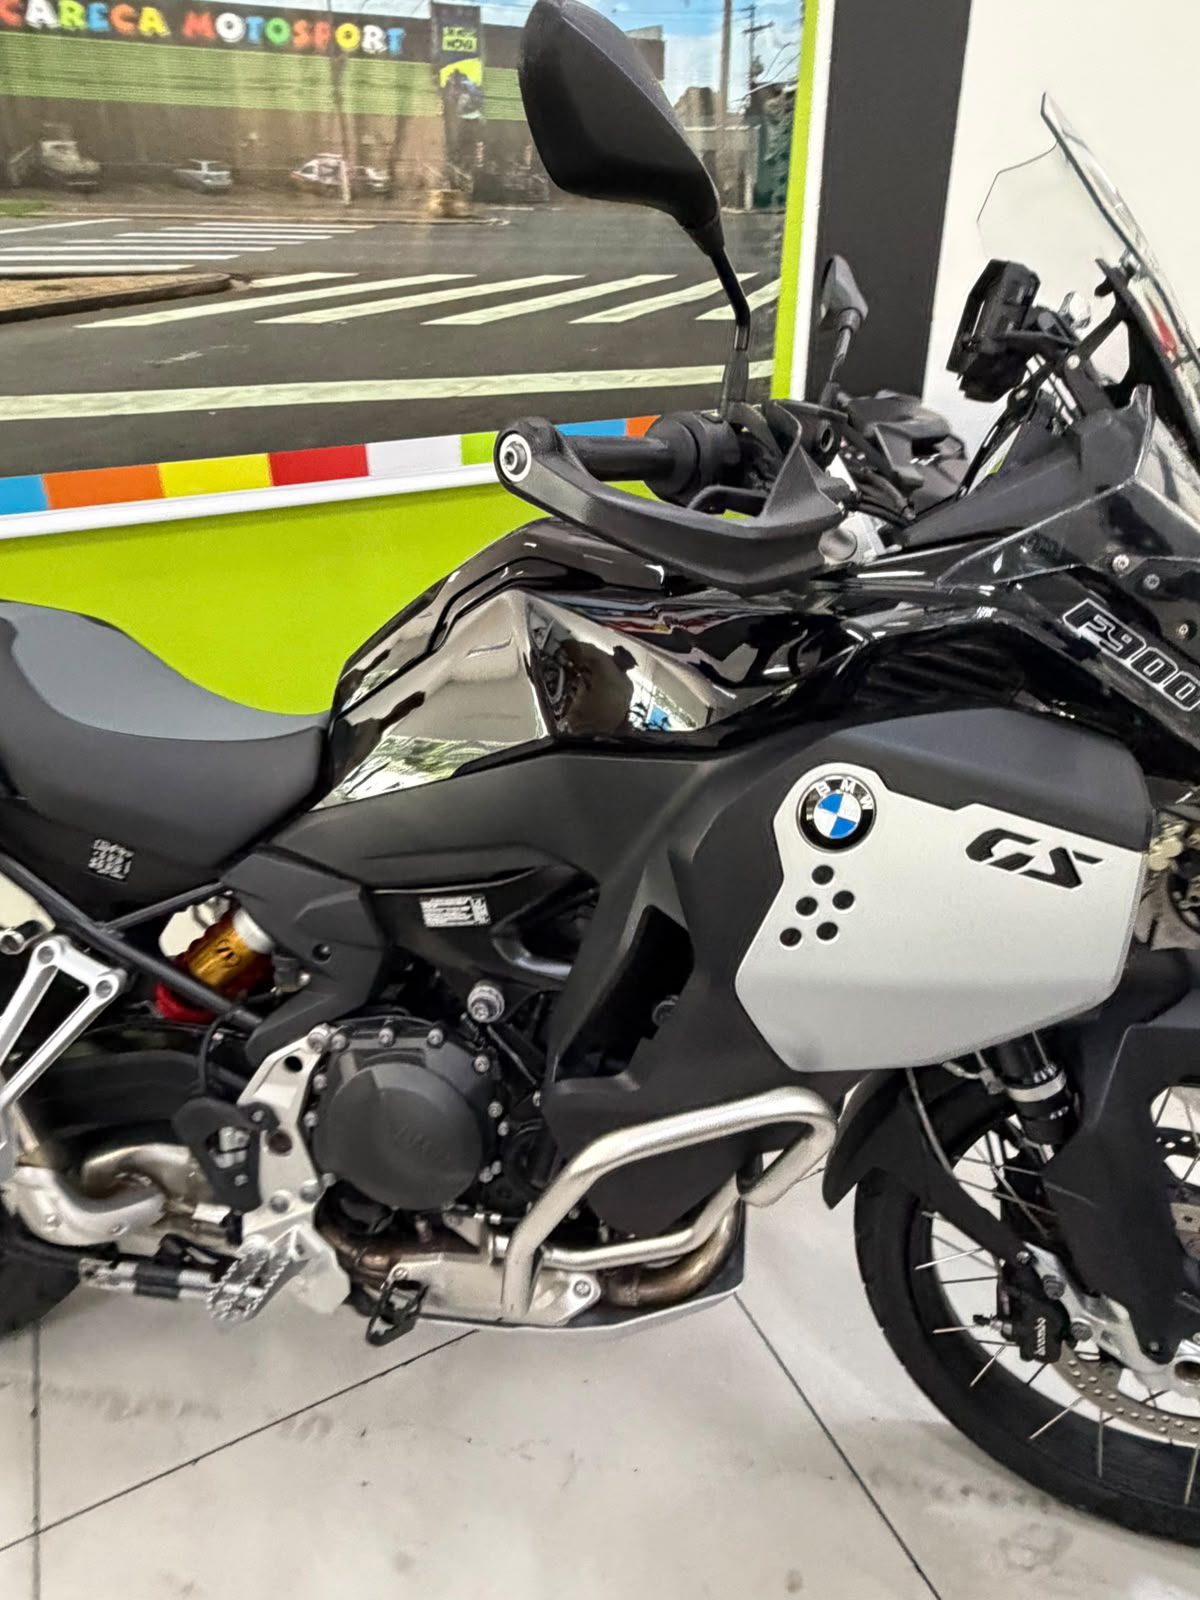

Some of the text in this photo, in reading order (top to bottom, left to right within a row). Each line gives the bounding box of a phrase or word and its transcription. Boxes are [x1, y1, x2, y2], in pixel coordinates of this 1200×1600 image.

[0, 0, 405, 55] CARECA MOTOSPORT
[1062, 598, 1200, 711] F900
[815, 777, 874, 811] BMW
